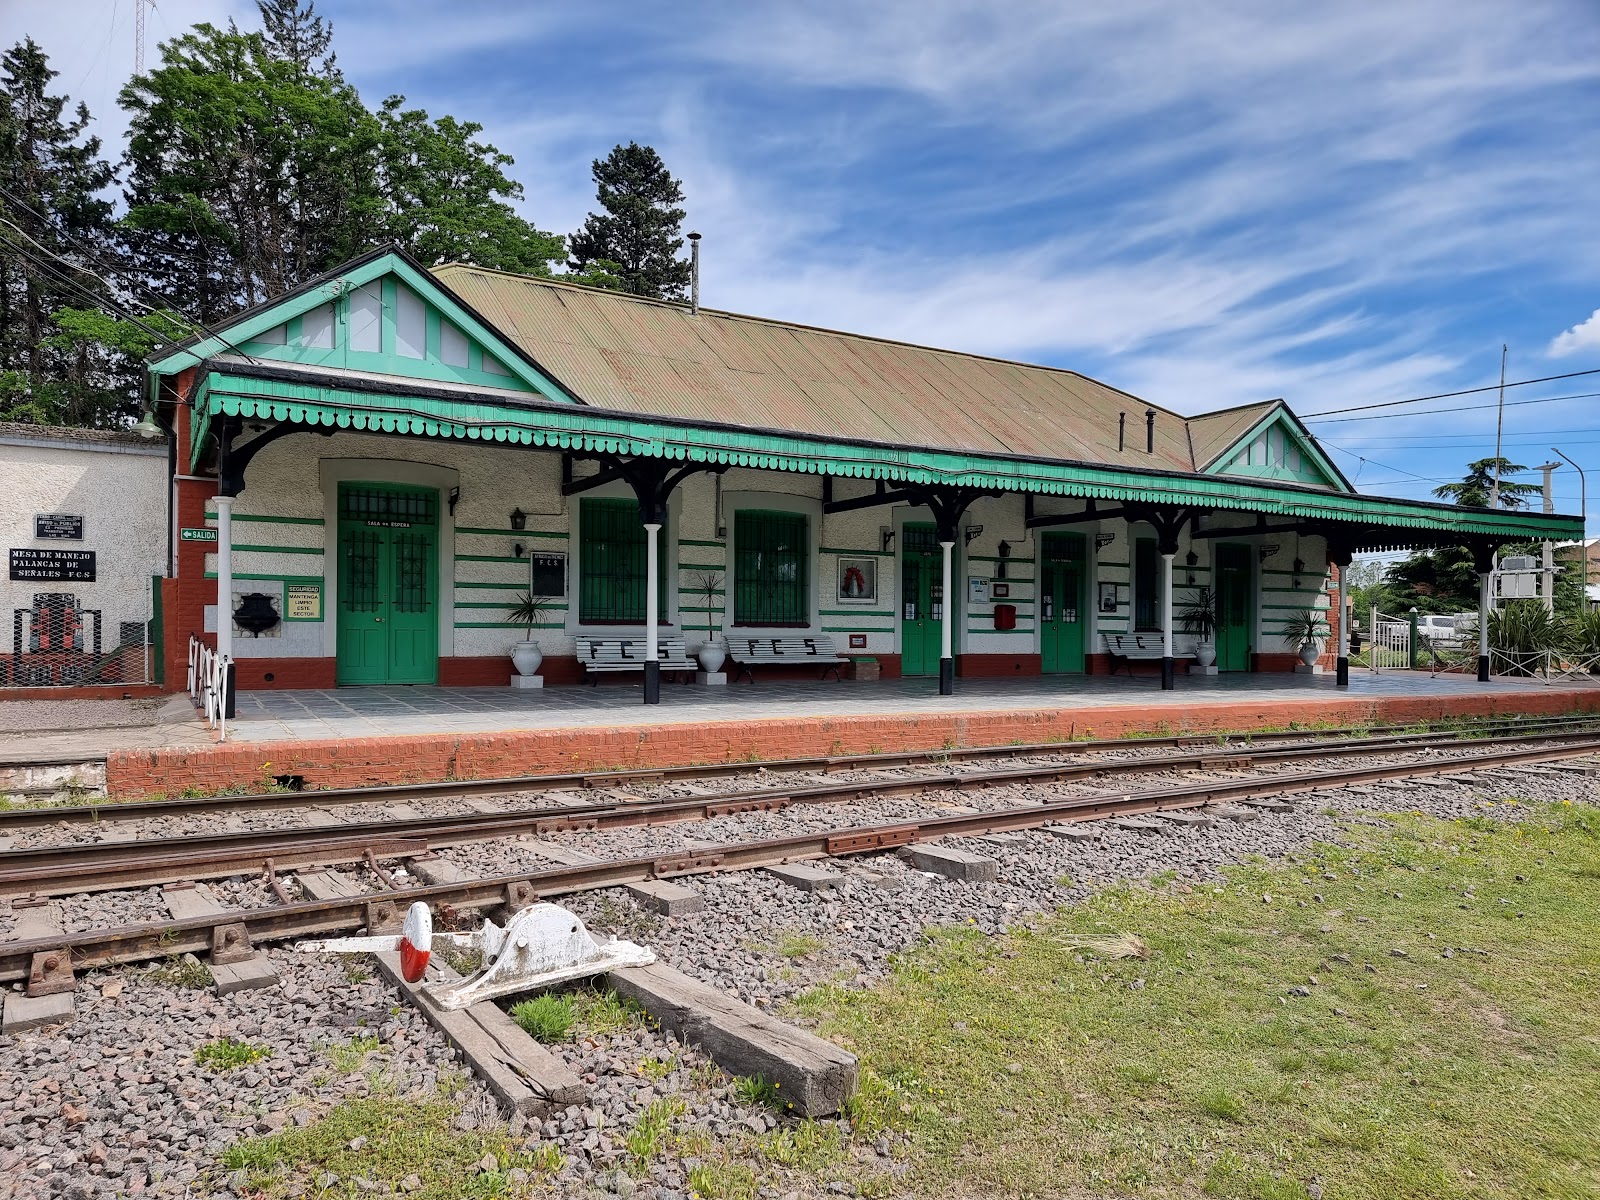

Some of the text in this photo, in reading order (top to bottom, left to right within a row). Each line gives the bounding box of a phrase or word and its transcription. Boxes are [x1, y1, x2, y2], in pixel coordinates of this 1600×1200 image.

[193, 531, 215, 540] SALIDA
[40, 551, 52, 559] DE
[55, 552, 90, 560] MANEJO
[12, 560, 61, 568] PALANCAS
[18, 570, 61, 578] SEÑALES
